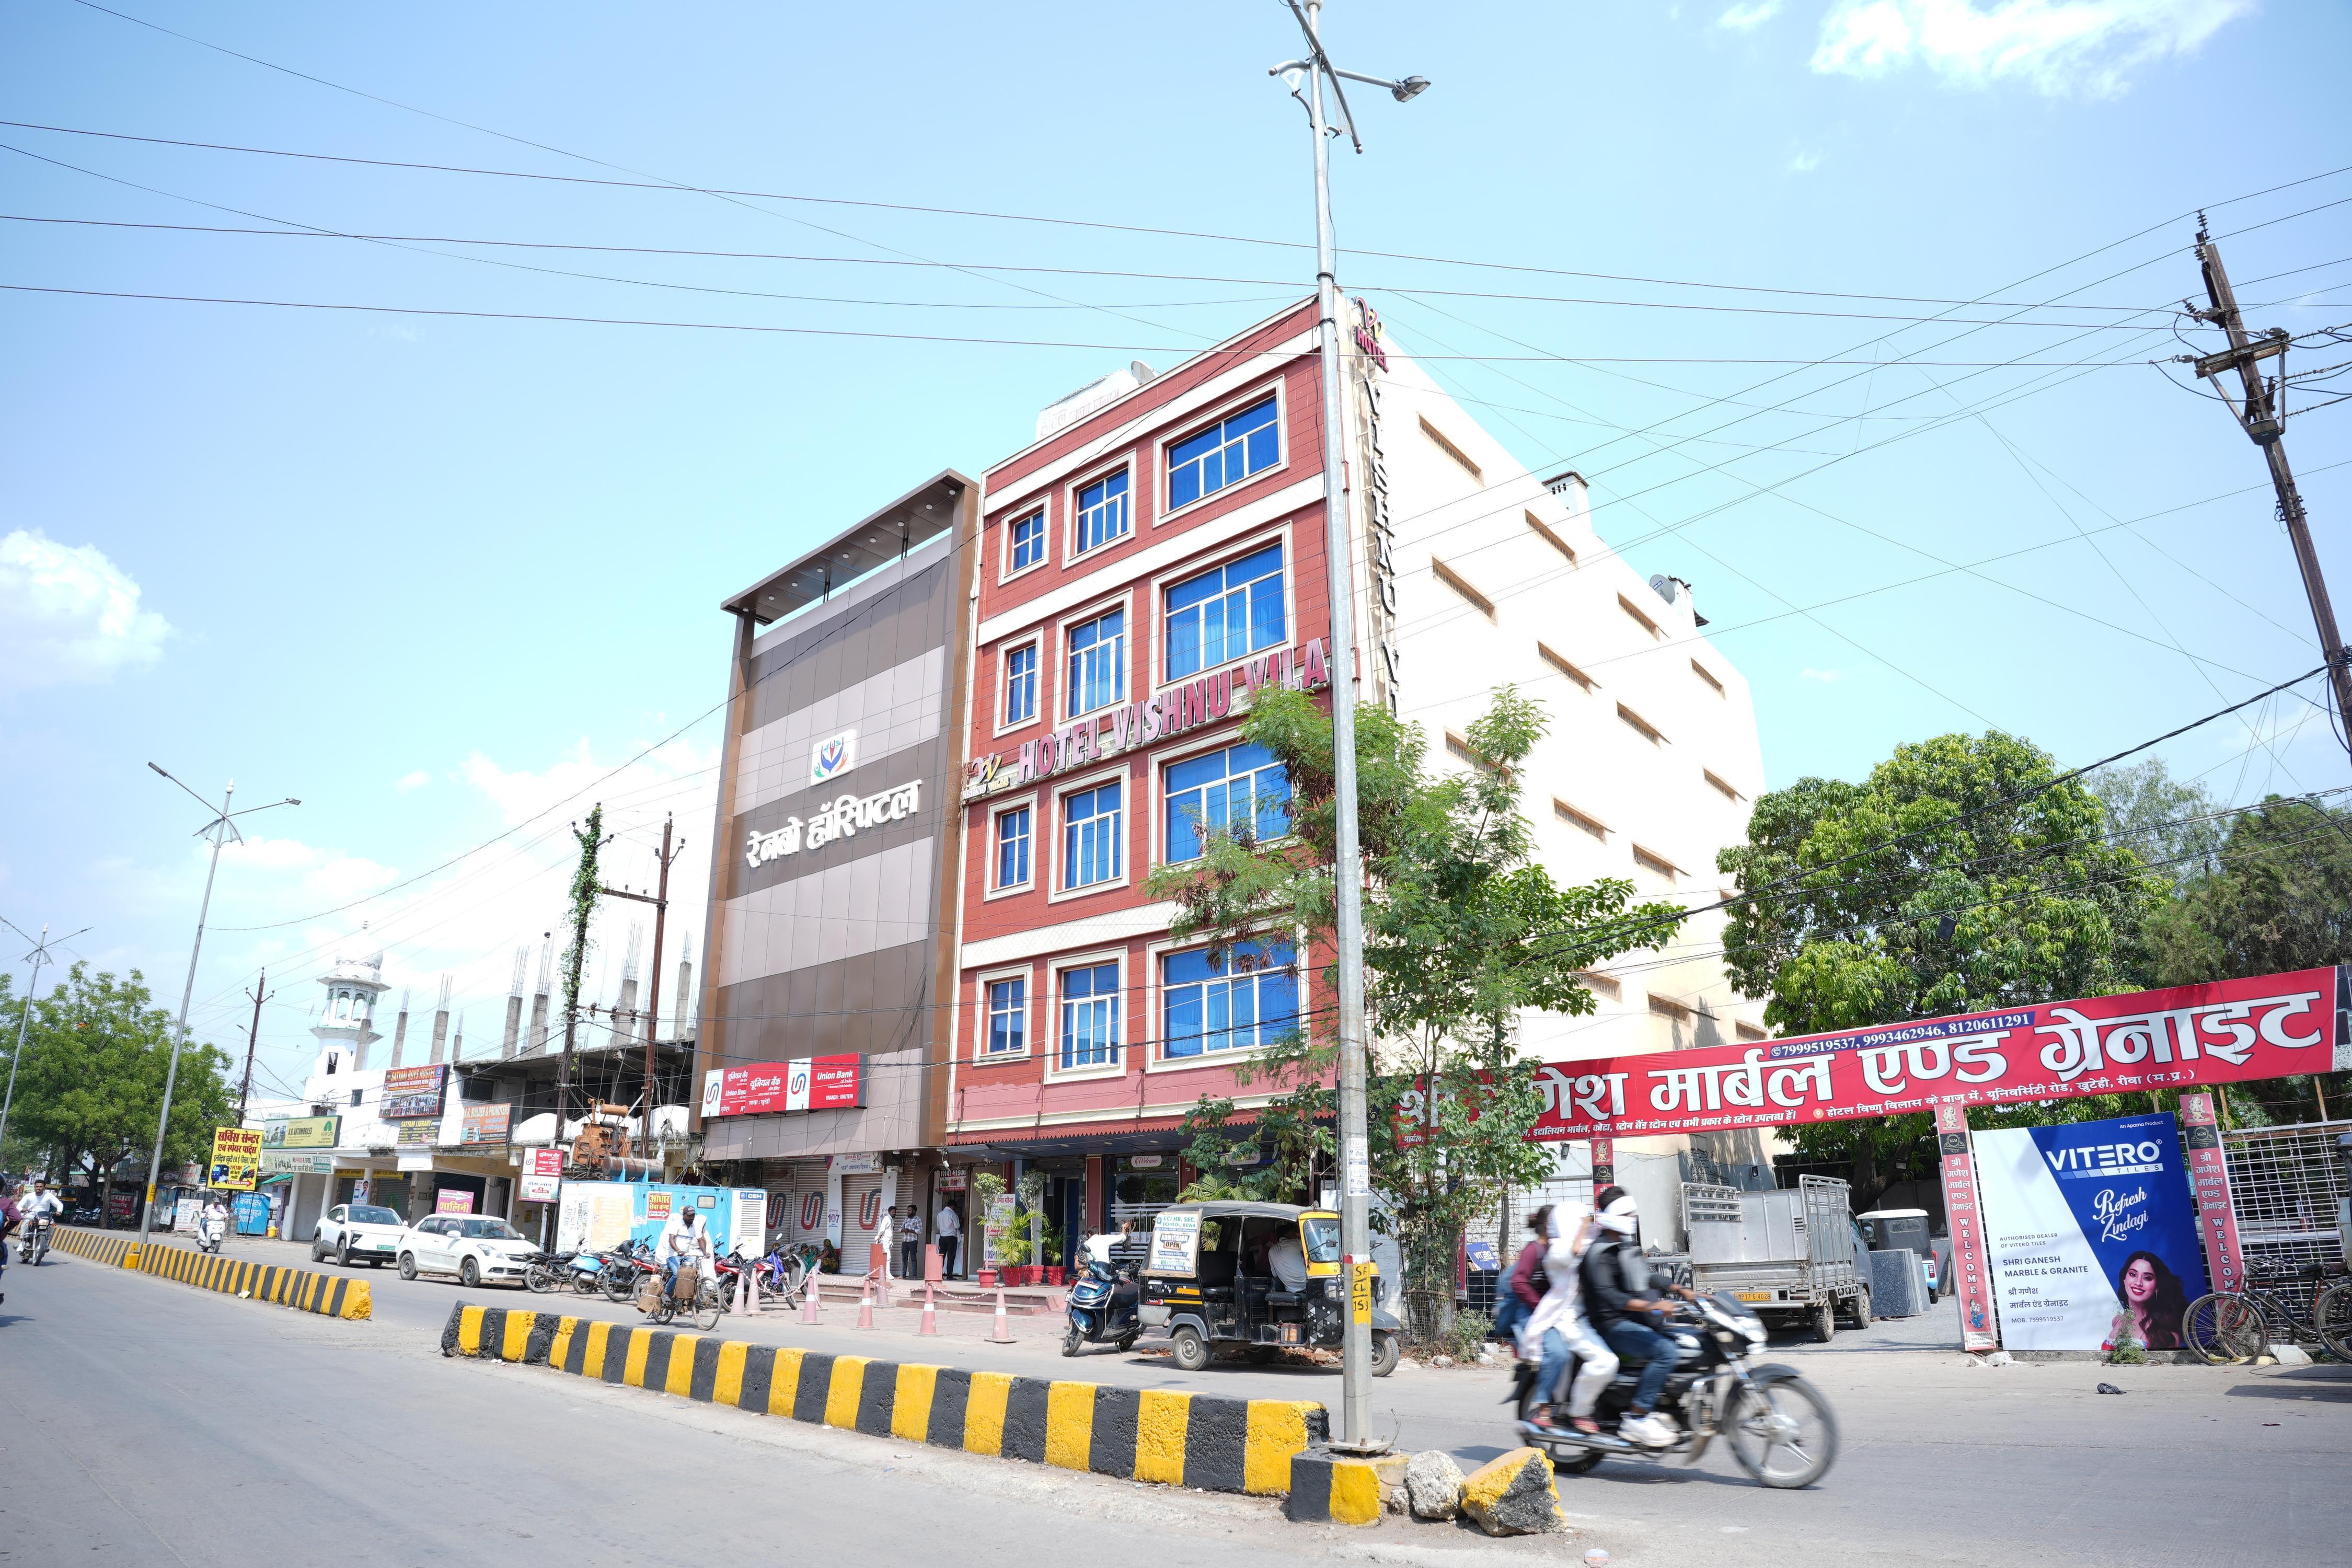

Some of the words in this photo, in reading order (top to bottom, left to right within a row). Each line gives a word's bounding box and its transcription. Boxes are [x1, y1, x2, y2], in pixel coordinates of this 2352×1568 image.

[1355, 326, 1389, 373] HOTEL
[1018, 718, 1102, 783] HOTEL
[1112, 671, 1232, 751] VISHNU
[1243, 638, 1331, 706] VILA
[746, 816, 804, 868] रेनबो
[806, 779, 924, 849] हॉस्पिटल
[1782, 1037, 1860, 1056] 7999519537,
[1863, 1027, 1944, 1046] 9993462946,
[1950, 1014, 2029, 1034] 8120611291
[1647, 1048, 1836, 1112] मार्बल
[1857, 1030, 2011, 1095] एण्ड
[2034, 991, 2323, 1082] ग्रेनाइट
[419, 1067, 435, 1079] HOSTEL
[817, 1071, 835, 1080] Union
[836, 1069, 854, 1079] Bank
[750, 1077, 770, 1090] यूनियन
[771, 1076, 781, 1086] बैंक
[1826, 1105, 1854, 1118] होटल
[1857, 1103, 1884, 1116] विष्णु
[1885, 1098, 1922, 1111] विलास
[1924, 1094, 1938, 1106] के
[1943, 1092, 1968, 1105] बाजू
[1986, 1082, 2046, 1101] यूनिवर्सिटी
[2049, 1081, 2073, 1093] रोड,
[2076, 1076, 2113, 1092] खुटेही,
[2116, 1075, 2142, 1086] रीवा
[1533, 1125, 1565, 1136] इटालियन
[1567, 1123, 1590, 1134] मार्बल,
[1593, 1122, 1612, 1132] कोटा,
[1616, 1120, 1634, 1130] स्टोन
[1648, 1119, 1667, 1129] स्टोन
[1669, 1117, 1681, 1128] एवं
[1682, 1116, 1699, 1127] सभी
[1701, 1115, 1722, 1126] प्रकार
[1723, 1114, 1732, 1124] के
[1733, 1113, 1753, 1124] स्टोन
[1755, 1111, 1784, 1122] उपलब्ध
[218, 1129, 240, 1142] सर्विस
[1135, 1157, 1158, 1166] Welcome
[1951, 1157, 1961, 1167] श्री
[2045, 1142, 2160, 1171] VITERO
[2200, 1151, 2211, 1162] श्री
[1947, 1169, 1968, 1178] गणेश
[2117, 1165, 2159, 1173] TILES
[2195, 1164, 2220, 1174] गणेश
[1948, 1180, 1971, 1189] मार्बल
[2197, 1176, 2223, 1186] मार्बल
[2201, 1190, 2220, 1198] एण्ड
[649, 1195, 671, 1205] आधार
[2093, 1186, 2147, 1220] Refresh
[440, 1201, 470, 1213] शालिनी
[1951, 1203, 1974, 1211] ग्रेनाइट
[2202, 1201, 2228, 1211] ग्रेनाइट
[2101, 1210, 2149, 1242] Zindagi
[1161, 1233, 1189, 1242] ADMISSION
[1958, 1218, 1977, 1295] WELCOME
[2211, 1217, 2235, 1289] WELCOM
[2024, 1256, 2060, 1264] GANESH
[2005, 1269, 2039, 1277] MARBLE
[2050, 1266, 2089, 1274] GRANITE
[2008, 1287, 2017, 1296] श्री
[2018, 1286, 2038, 1295] गणेश
[2009, 1300, 2031, 1309] मार्बल
[2043, 1299, 2069, 1307] ग्रेनाइट
